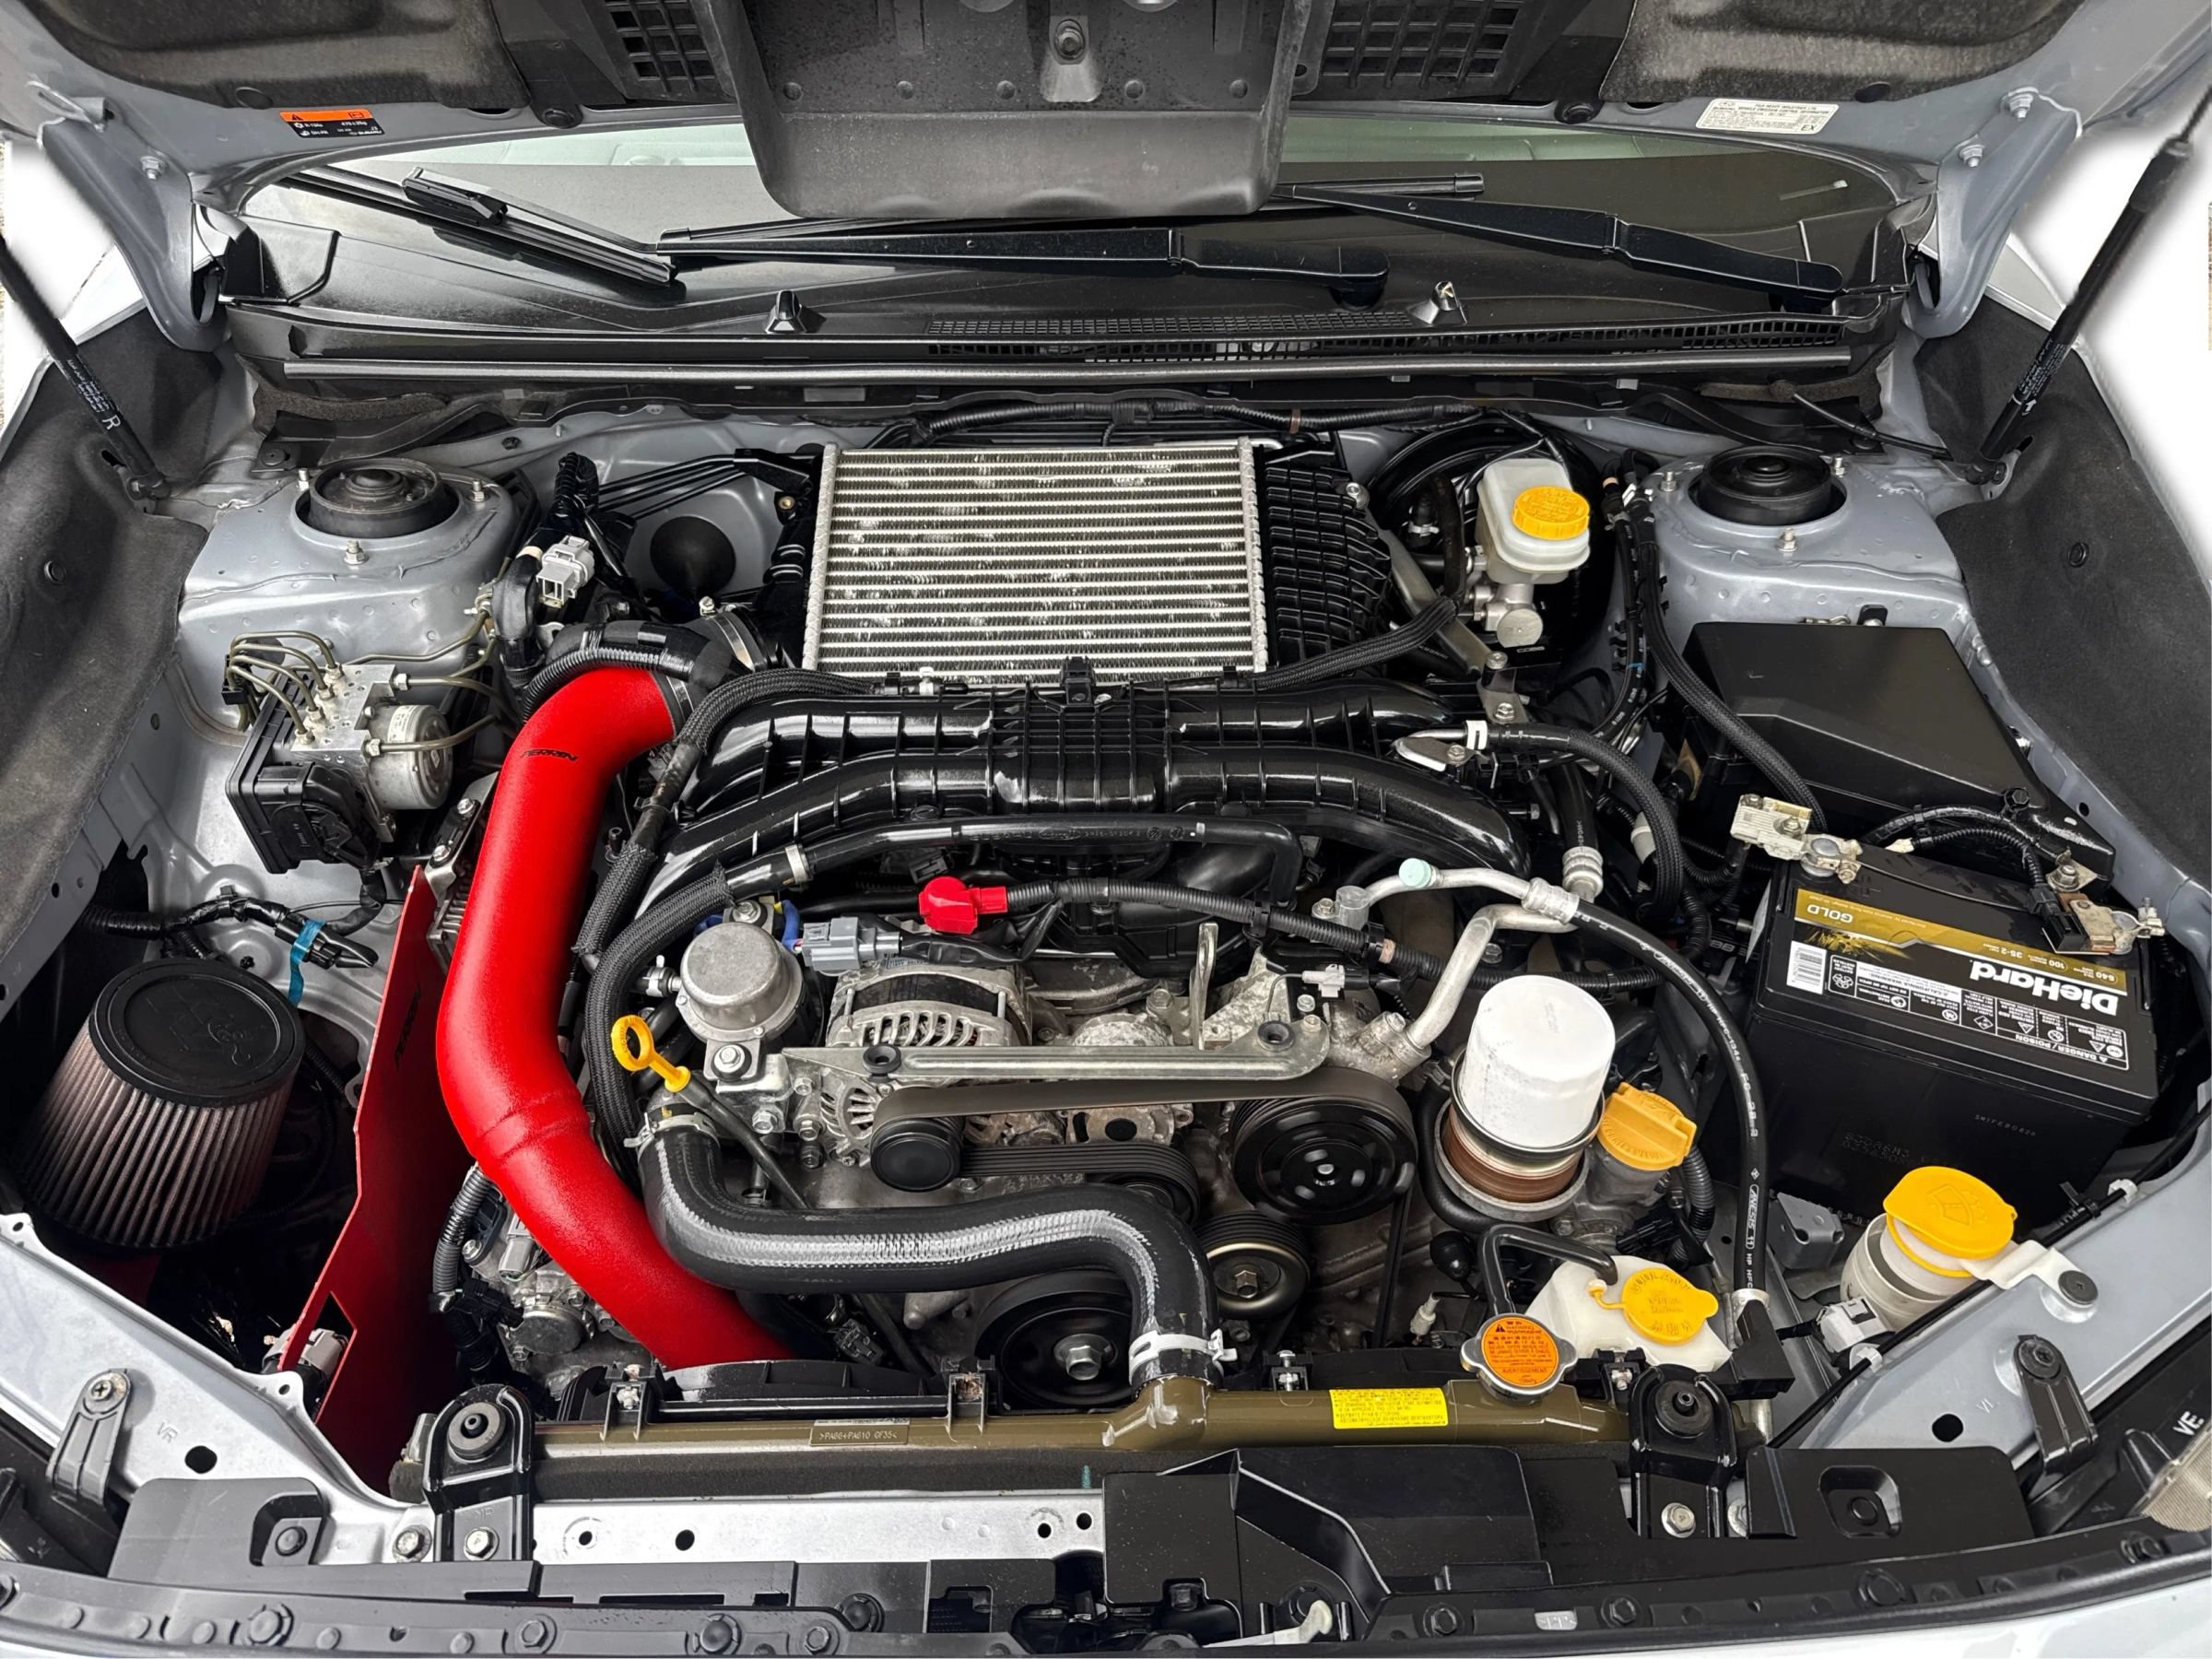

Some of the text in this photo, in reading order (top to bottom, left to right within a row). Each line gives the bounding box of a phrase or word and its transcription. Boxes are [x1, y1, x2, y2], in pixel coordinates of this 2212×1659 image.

[101, 414, 122, 430] R
[1806, 903, 1853, 923] GOLD
[1999, 947, 2023, 959] 35-2
[2047, 959, 2065, 969] 100
[2094, 971, 2115, 982] 640
[1970, 959, 2119, 1016] DieHard
[2014, 1033, 2051, 1048] POISON
[2056, 1044, 2097, 1060] DANGER
[1746, 1189, 1758, 1229] ANESIS
[1746, 1253, 1752, 1265] HP
[158, 1421, 179, 1443] VR
